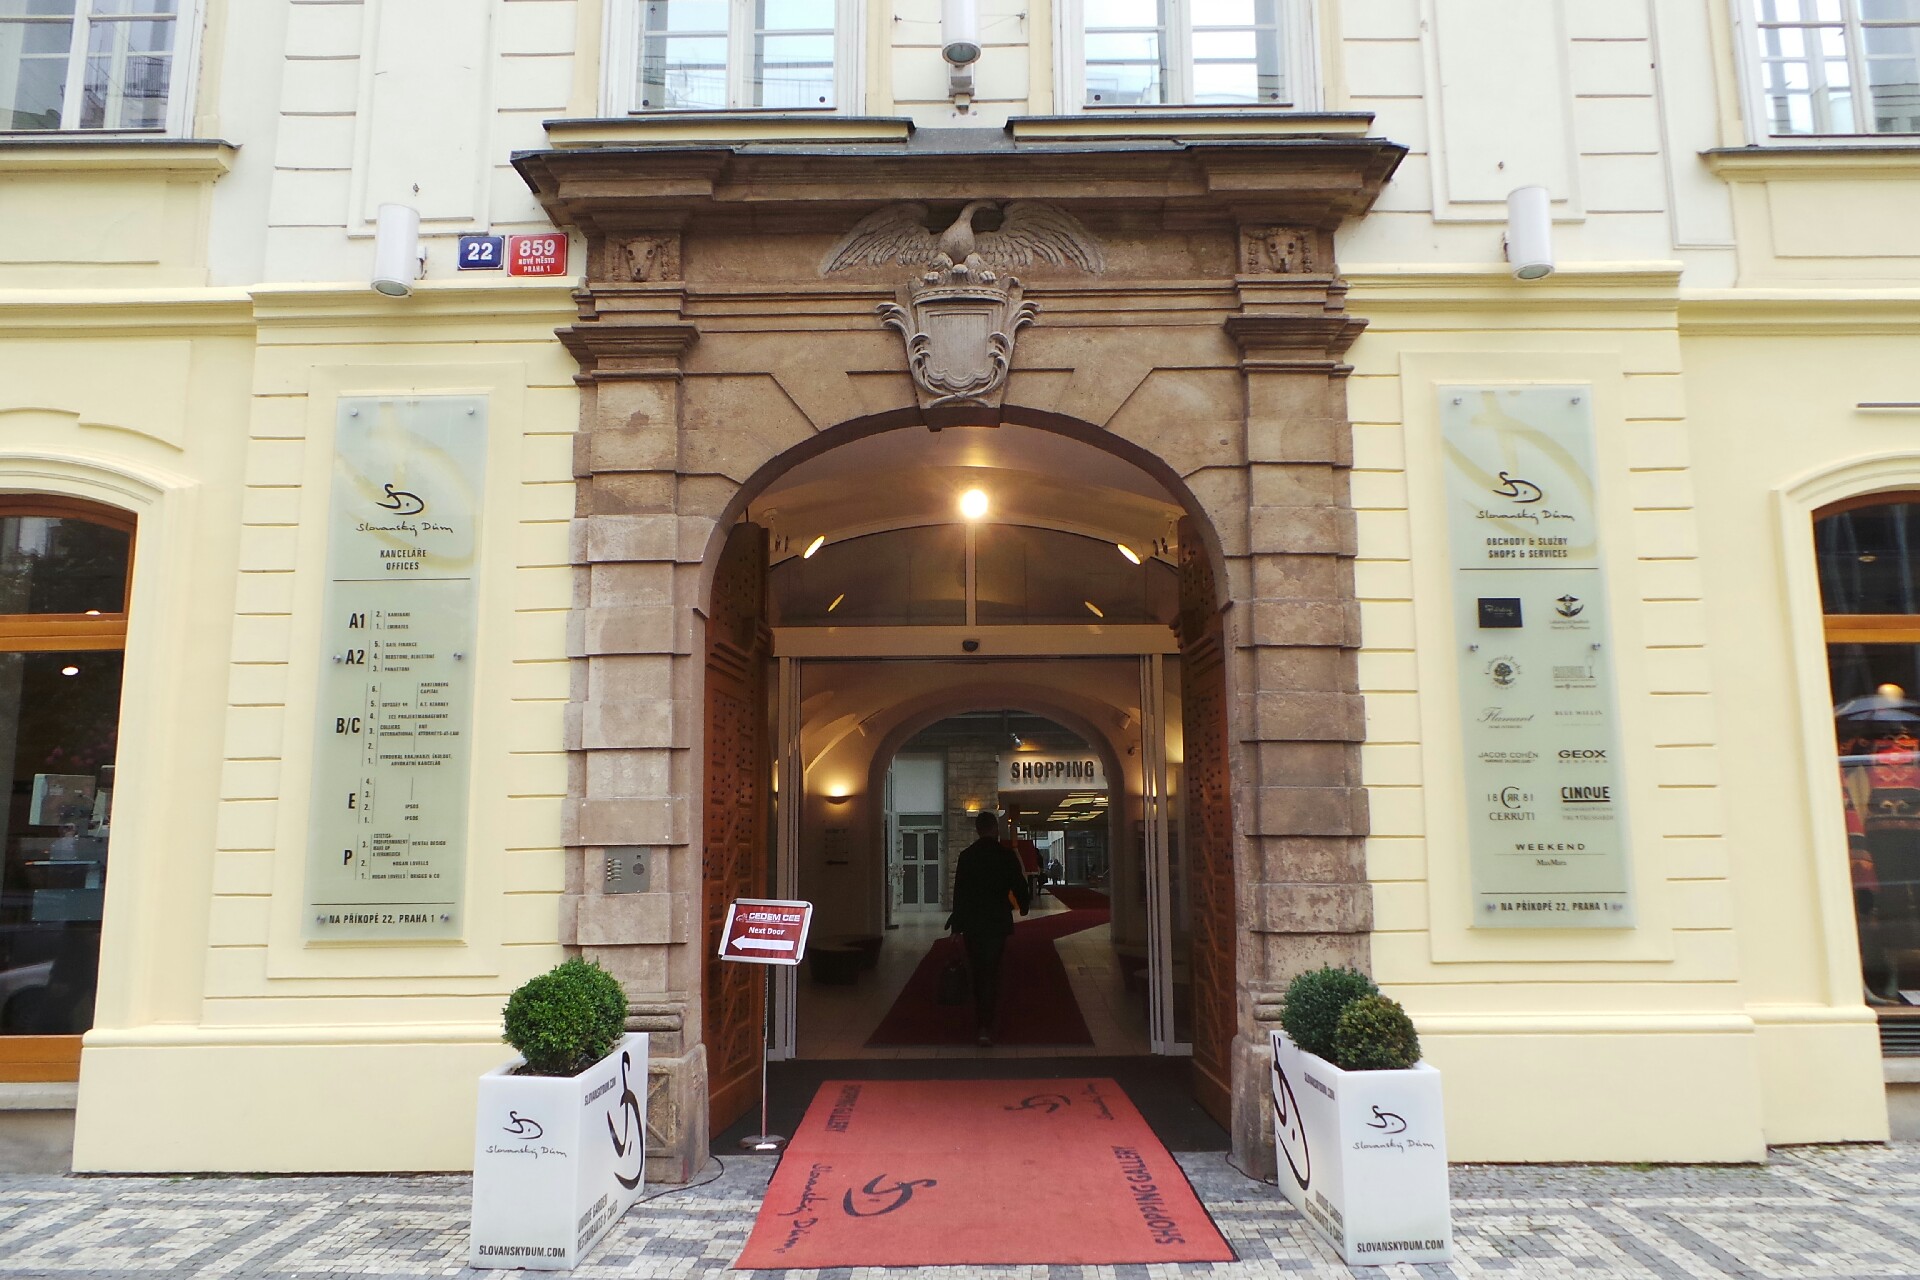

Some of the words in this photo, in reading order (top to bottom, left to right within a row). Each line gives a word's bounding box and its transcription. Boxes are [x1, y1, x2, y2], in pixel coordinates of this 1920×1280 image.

[467, 242, 493, 260] 22
[519, 239, 555, 257] 859
[518, 256, 534, 265] NOVÉ
[536, 256, 555, 264] MĚSTO
[1486, 537, 1526, 546] OBCHODY
[1538, 536, 1568, 546] SLUŽBY
[1488, 550, 1516, 559] SHOPS
[1519, 550, 1525, 558] &
[1529, 550, 1568, 558] SERVICES
[386, 562, 419, 570] OFFICES
[349, 613, 365, 628] A1
[345, 649, 365, 665] A2
[336, 717, 361, 735] B/C
[1558, 750, 1607, 759] GEOX
[1011, 760, 1094, 779] SHOPPING
[1561, 786, 1610, 799] CINQUE
[348, 793, 356, 809] E
[1489, 812, 1535, 821] CERRUTI
[1515, 843, 1585, 851] WEEKEND
[343, 849, 353, 866] P
[1501, 902, 1513, 911] NA
[1573, 902, 1600, 911] PRAHA
[1604, 902, 1608, 910] 1
[329, 914, 341, 924] NA
[399, 914, 428, 923] PRAHA
[431, 914, 435, 922] 1
[748, 926, 766, 935] Next
[767, 928, 785, 936] Door
[1111, 1145, 1152, 1182] GALLERY
[1130, 1185, 1186, 1244] SHOPPING
[478, 1245, 566, 1258] SLOVANSKYDUM.COM
[1357, 1240, 1444, 1253] SLOVANSKYDUM.COM
